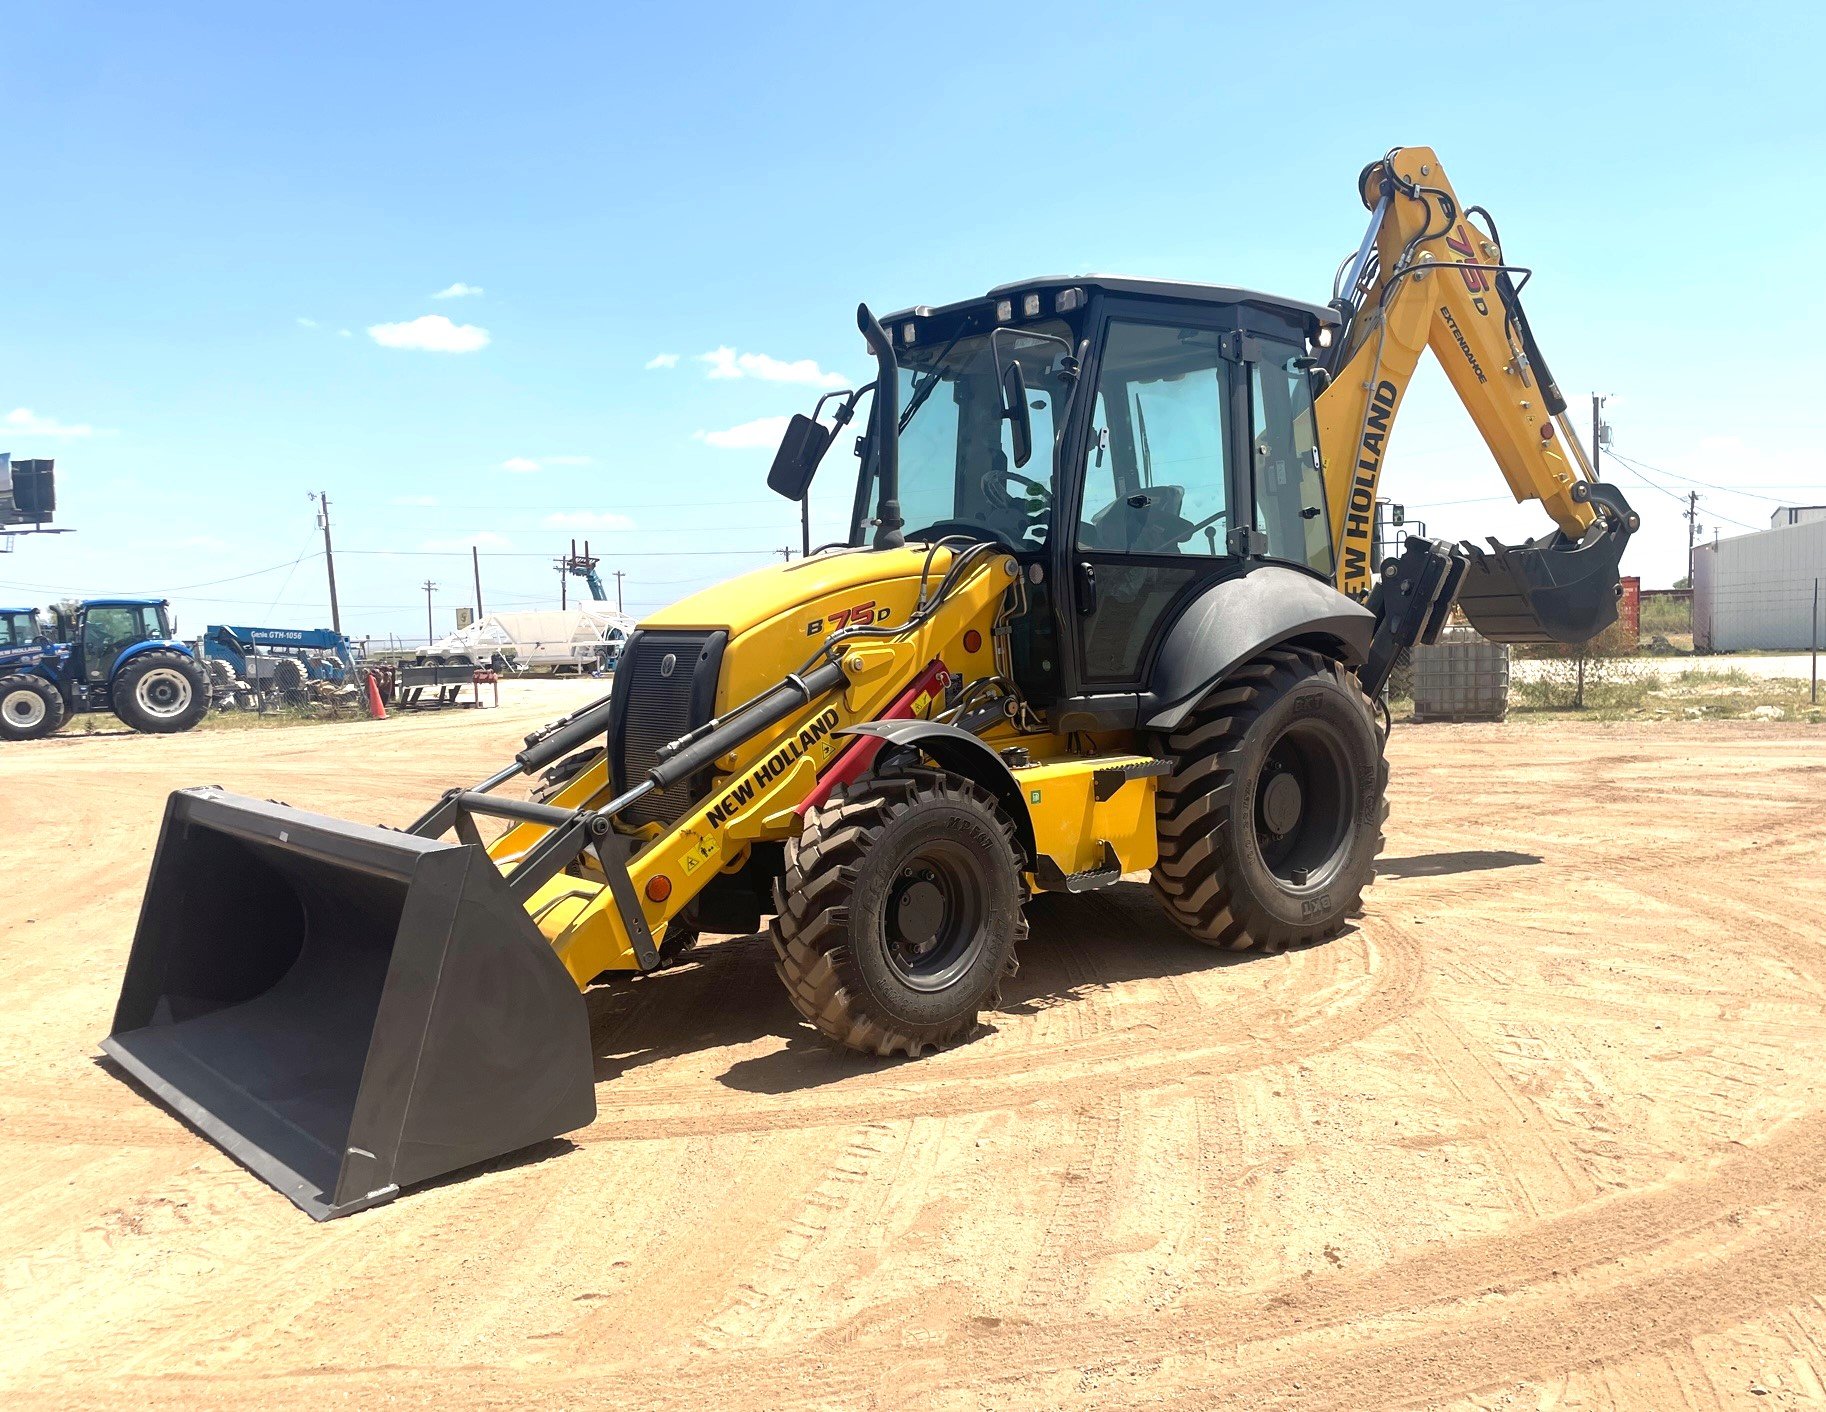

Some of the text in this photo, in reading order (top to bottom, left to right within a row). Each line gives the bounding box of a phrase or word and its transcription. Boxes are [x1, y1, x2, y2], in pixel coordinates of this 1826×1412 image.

[1440, 306, 1487, 384] EXTENDAHOE
[1344, 380, 1398, 601] EW HOLLAND
[269, 631, 303, 640] GTH-1056
[705, 708, 840, 829] NEW HOLLAND
[1300, 894, 1331, 920] BKT
